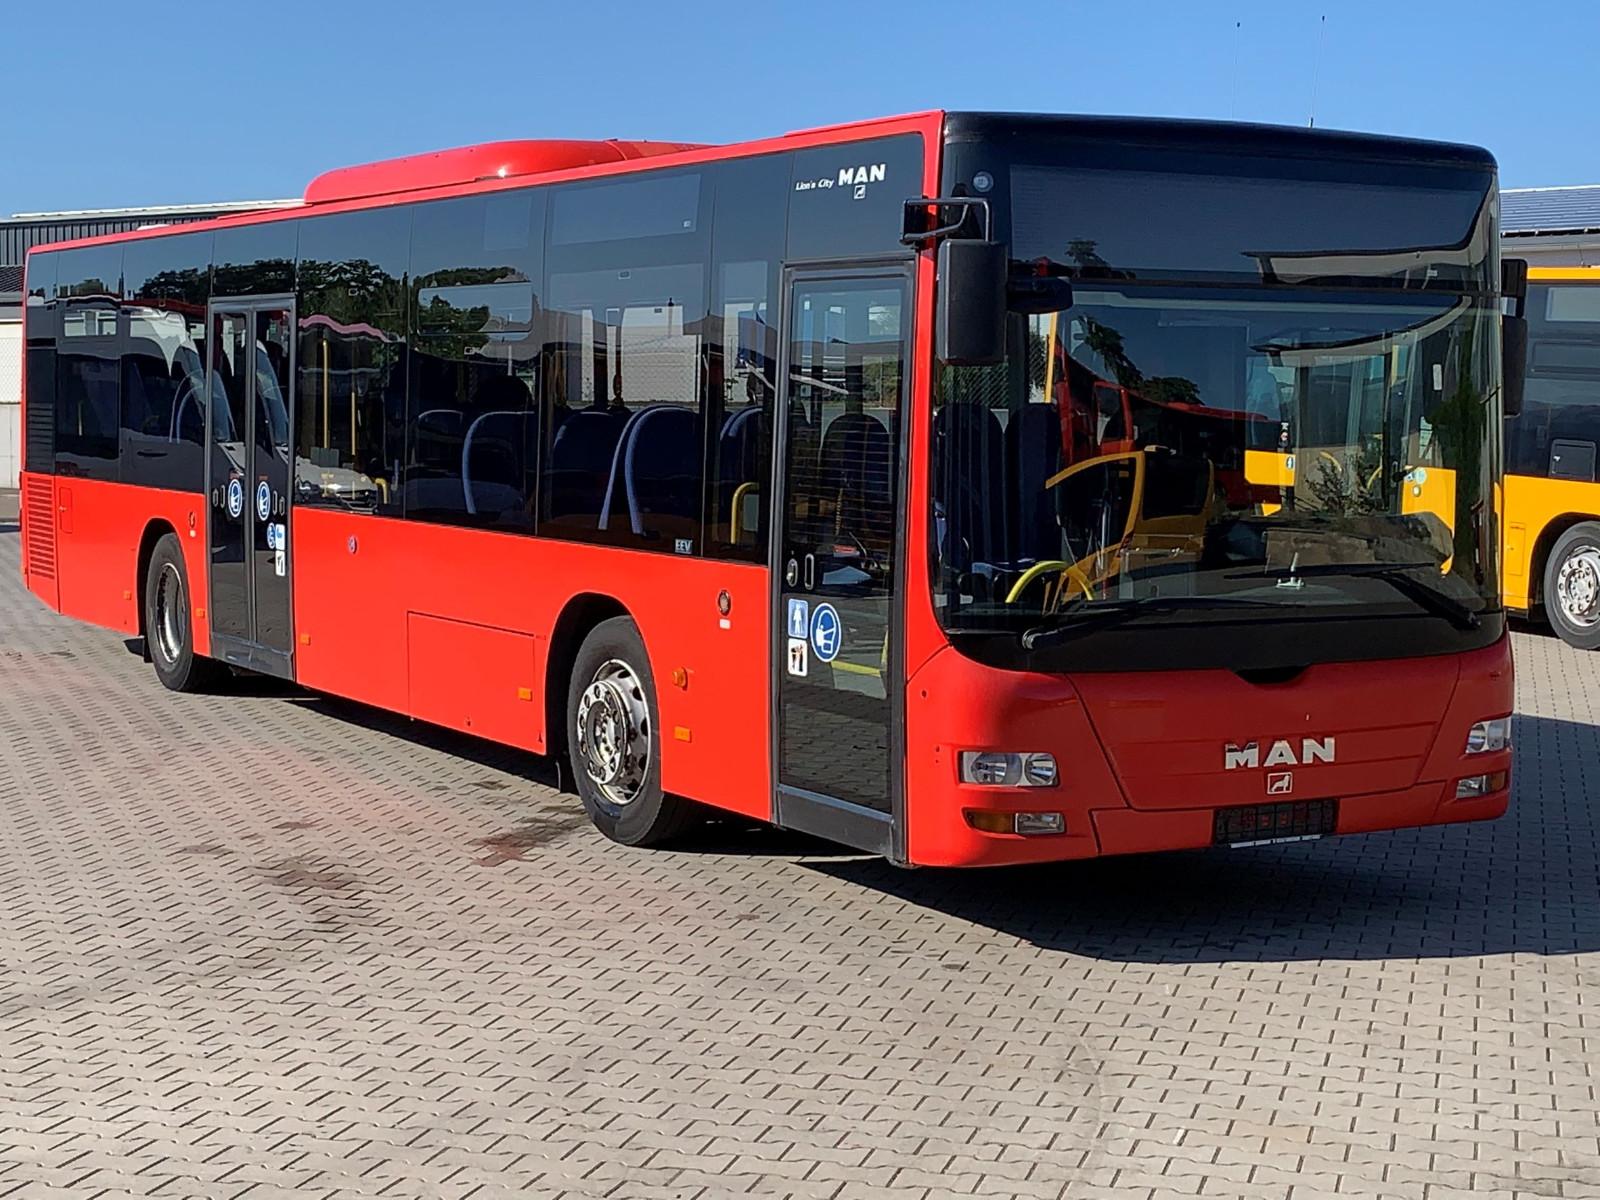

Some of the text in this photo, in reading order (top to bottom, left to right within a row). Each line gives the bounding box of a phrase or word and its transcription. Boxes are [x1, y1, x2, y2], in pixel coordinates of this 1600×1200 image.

[795, 163, 886, 191] Lion's City MAN
[675, 538, 693, 552] EEV
[1225, 737, 1336, 770] MAN
